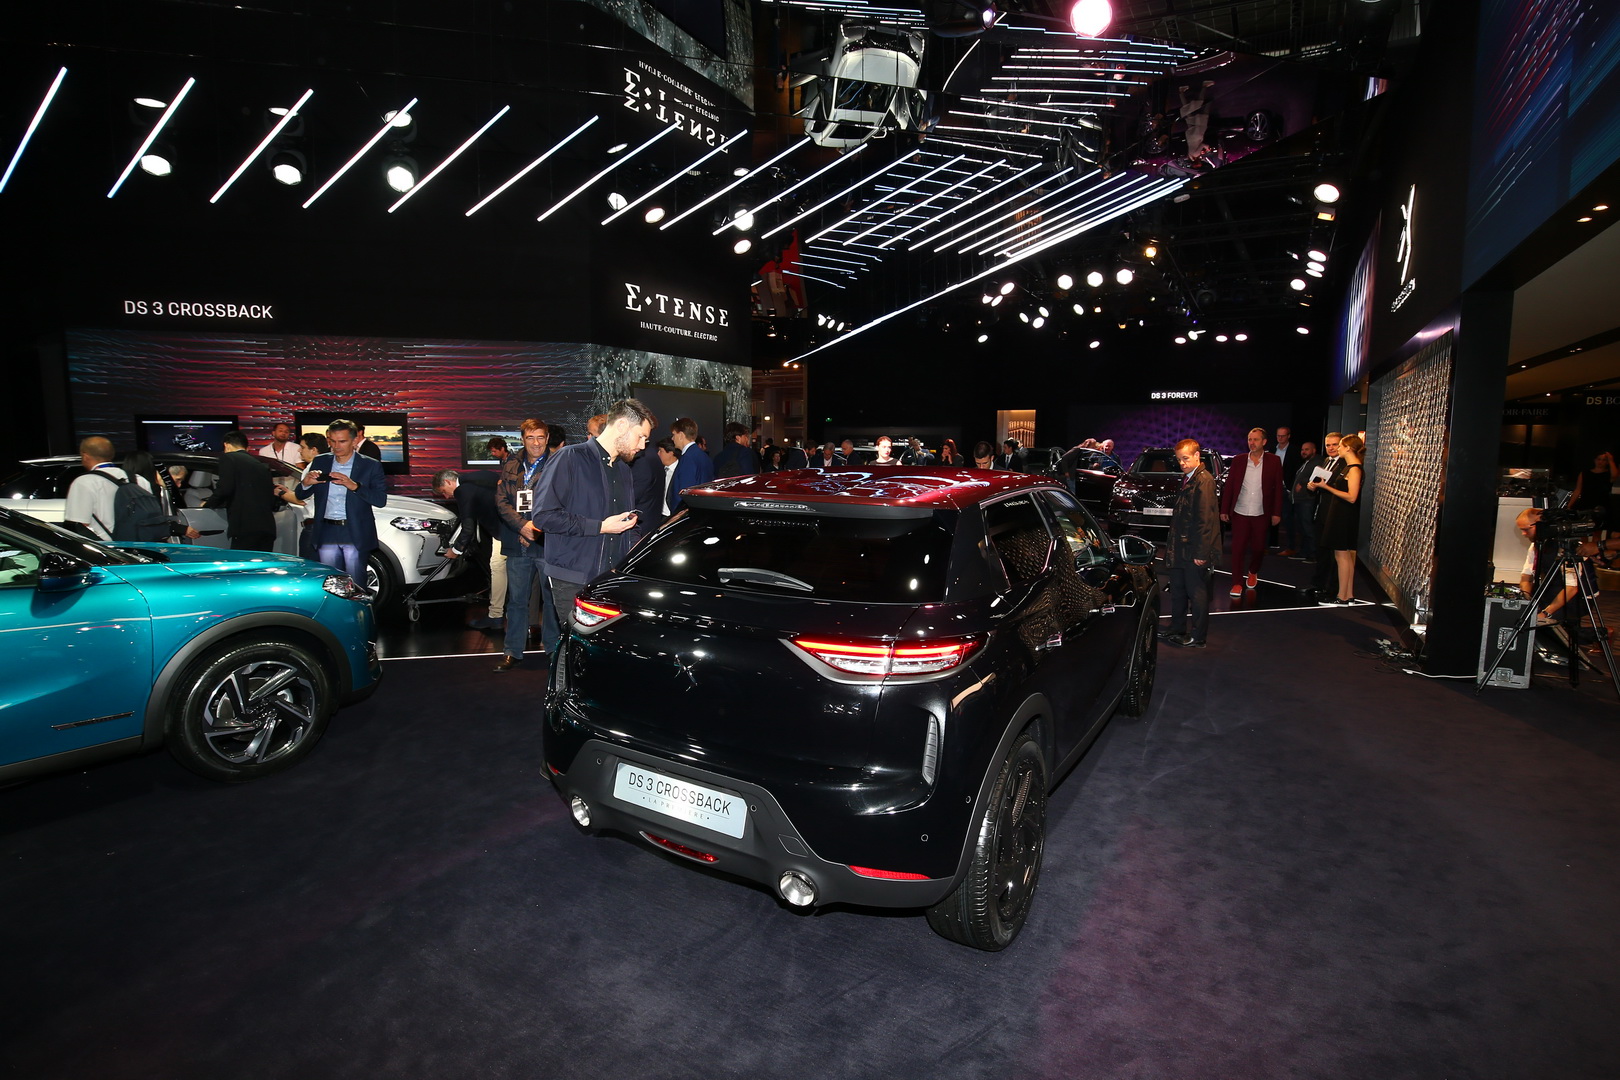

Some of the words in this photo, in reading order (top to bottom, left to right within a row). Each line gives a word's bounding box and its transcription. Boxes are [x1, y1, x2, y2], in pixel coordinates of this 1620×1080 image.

[124, 300, 148, 315] DS
[152, 301, 164, 316] 3
[168, 302, 273, 319] CROSSBACK
[693, 331, 718, 342] ELECTRIC
[1167, 391, 1198, 399] FOREVER
[1586, 396, 1603, 406] DS
[628, 772, 644, 788] DS
[646, 778, 654, 791] 3
[656, 781, 731, 816] CROSSBACK
